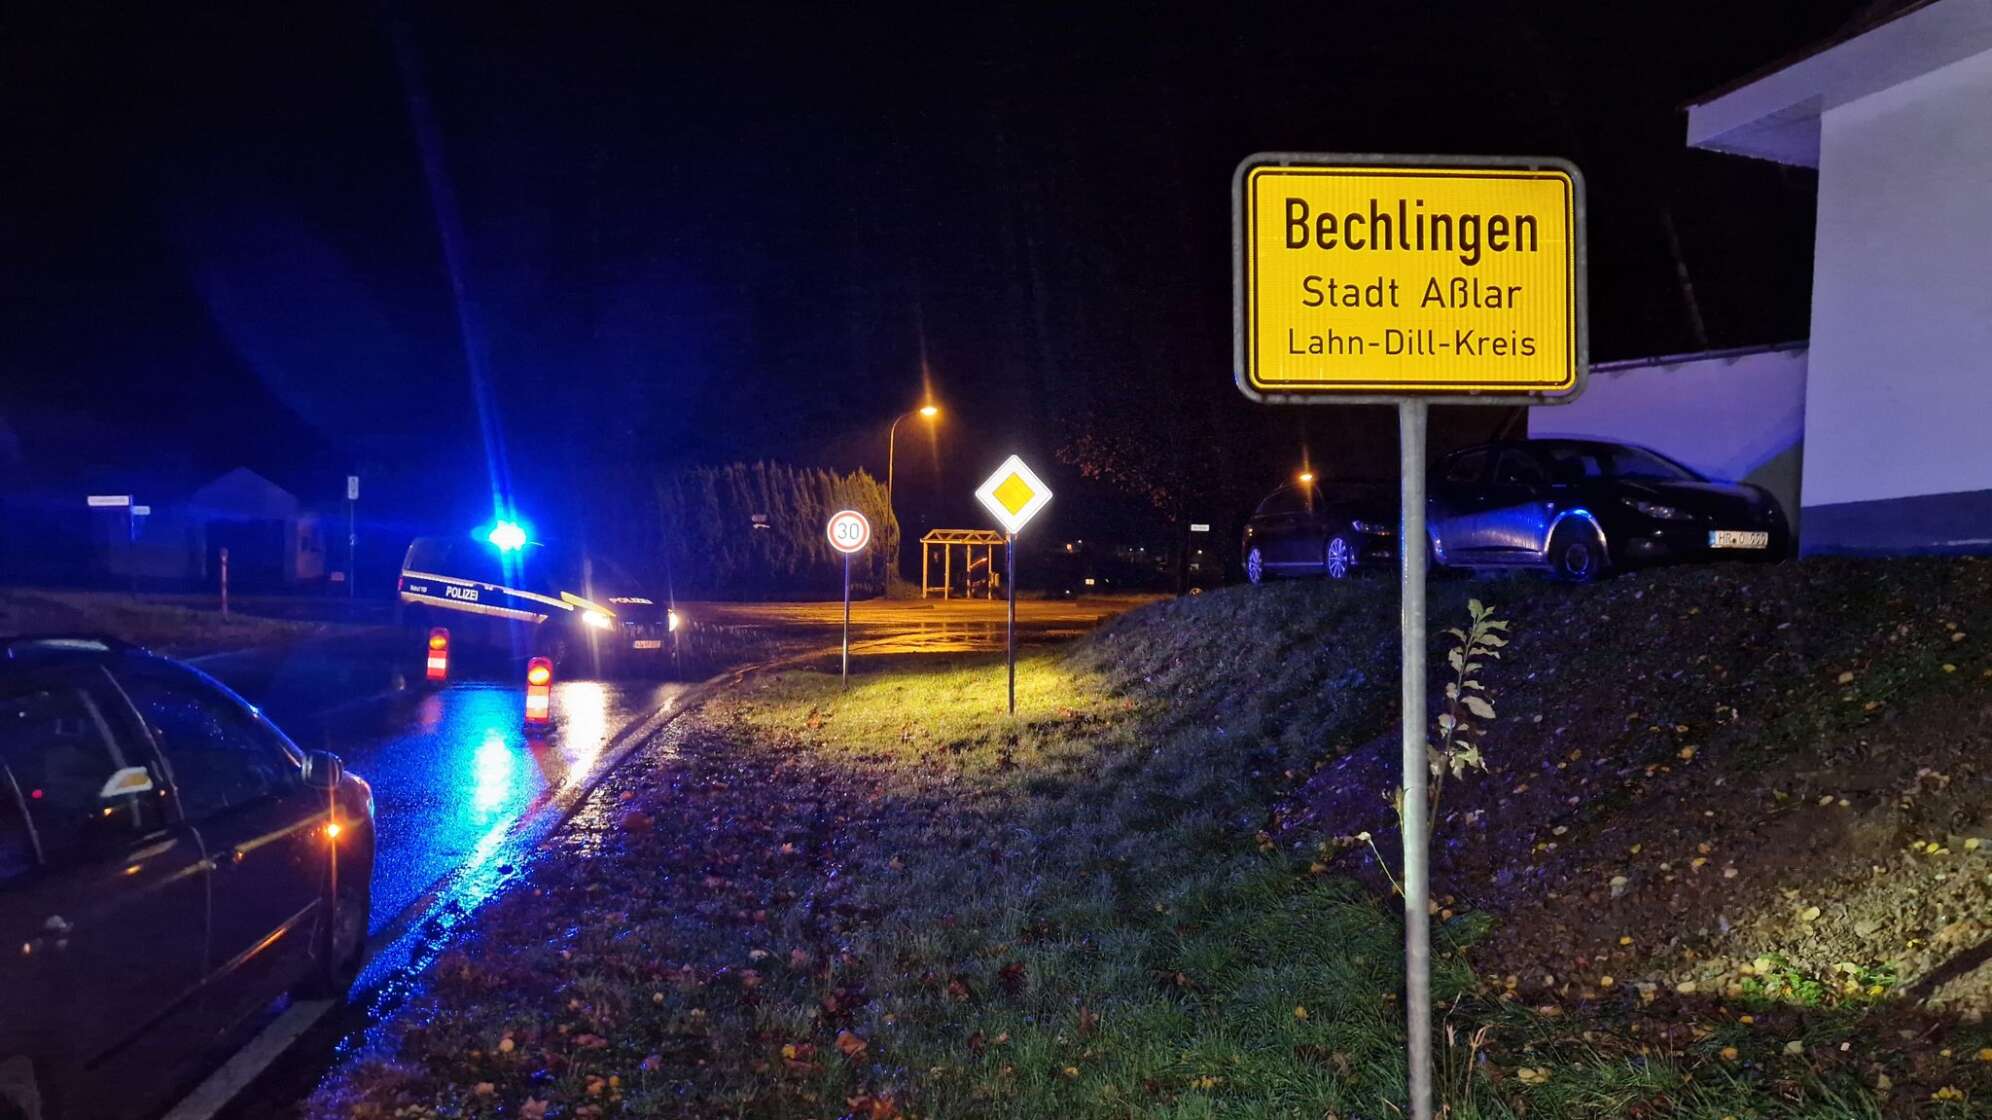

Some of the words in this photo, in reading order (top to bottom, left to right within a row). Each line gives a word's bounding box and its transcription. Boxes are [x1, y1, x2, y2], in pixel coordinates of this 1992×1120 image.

[1286, 198, 1537, 266] Bechlingen
[1303, 276, 1398, 307] Stadt
[1421, 277, 1522, 308] Aßlar
[1290, 329, 1535, 356] Lahn-Dill-Kreis
[837, 522, 859, 540] 30
[445, 585, 479, 601] POLIZEI
[608, 596, 653, 604] POLIZEI
